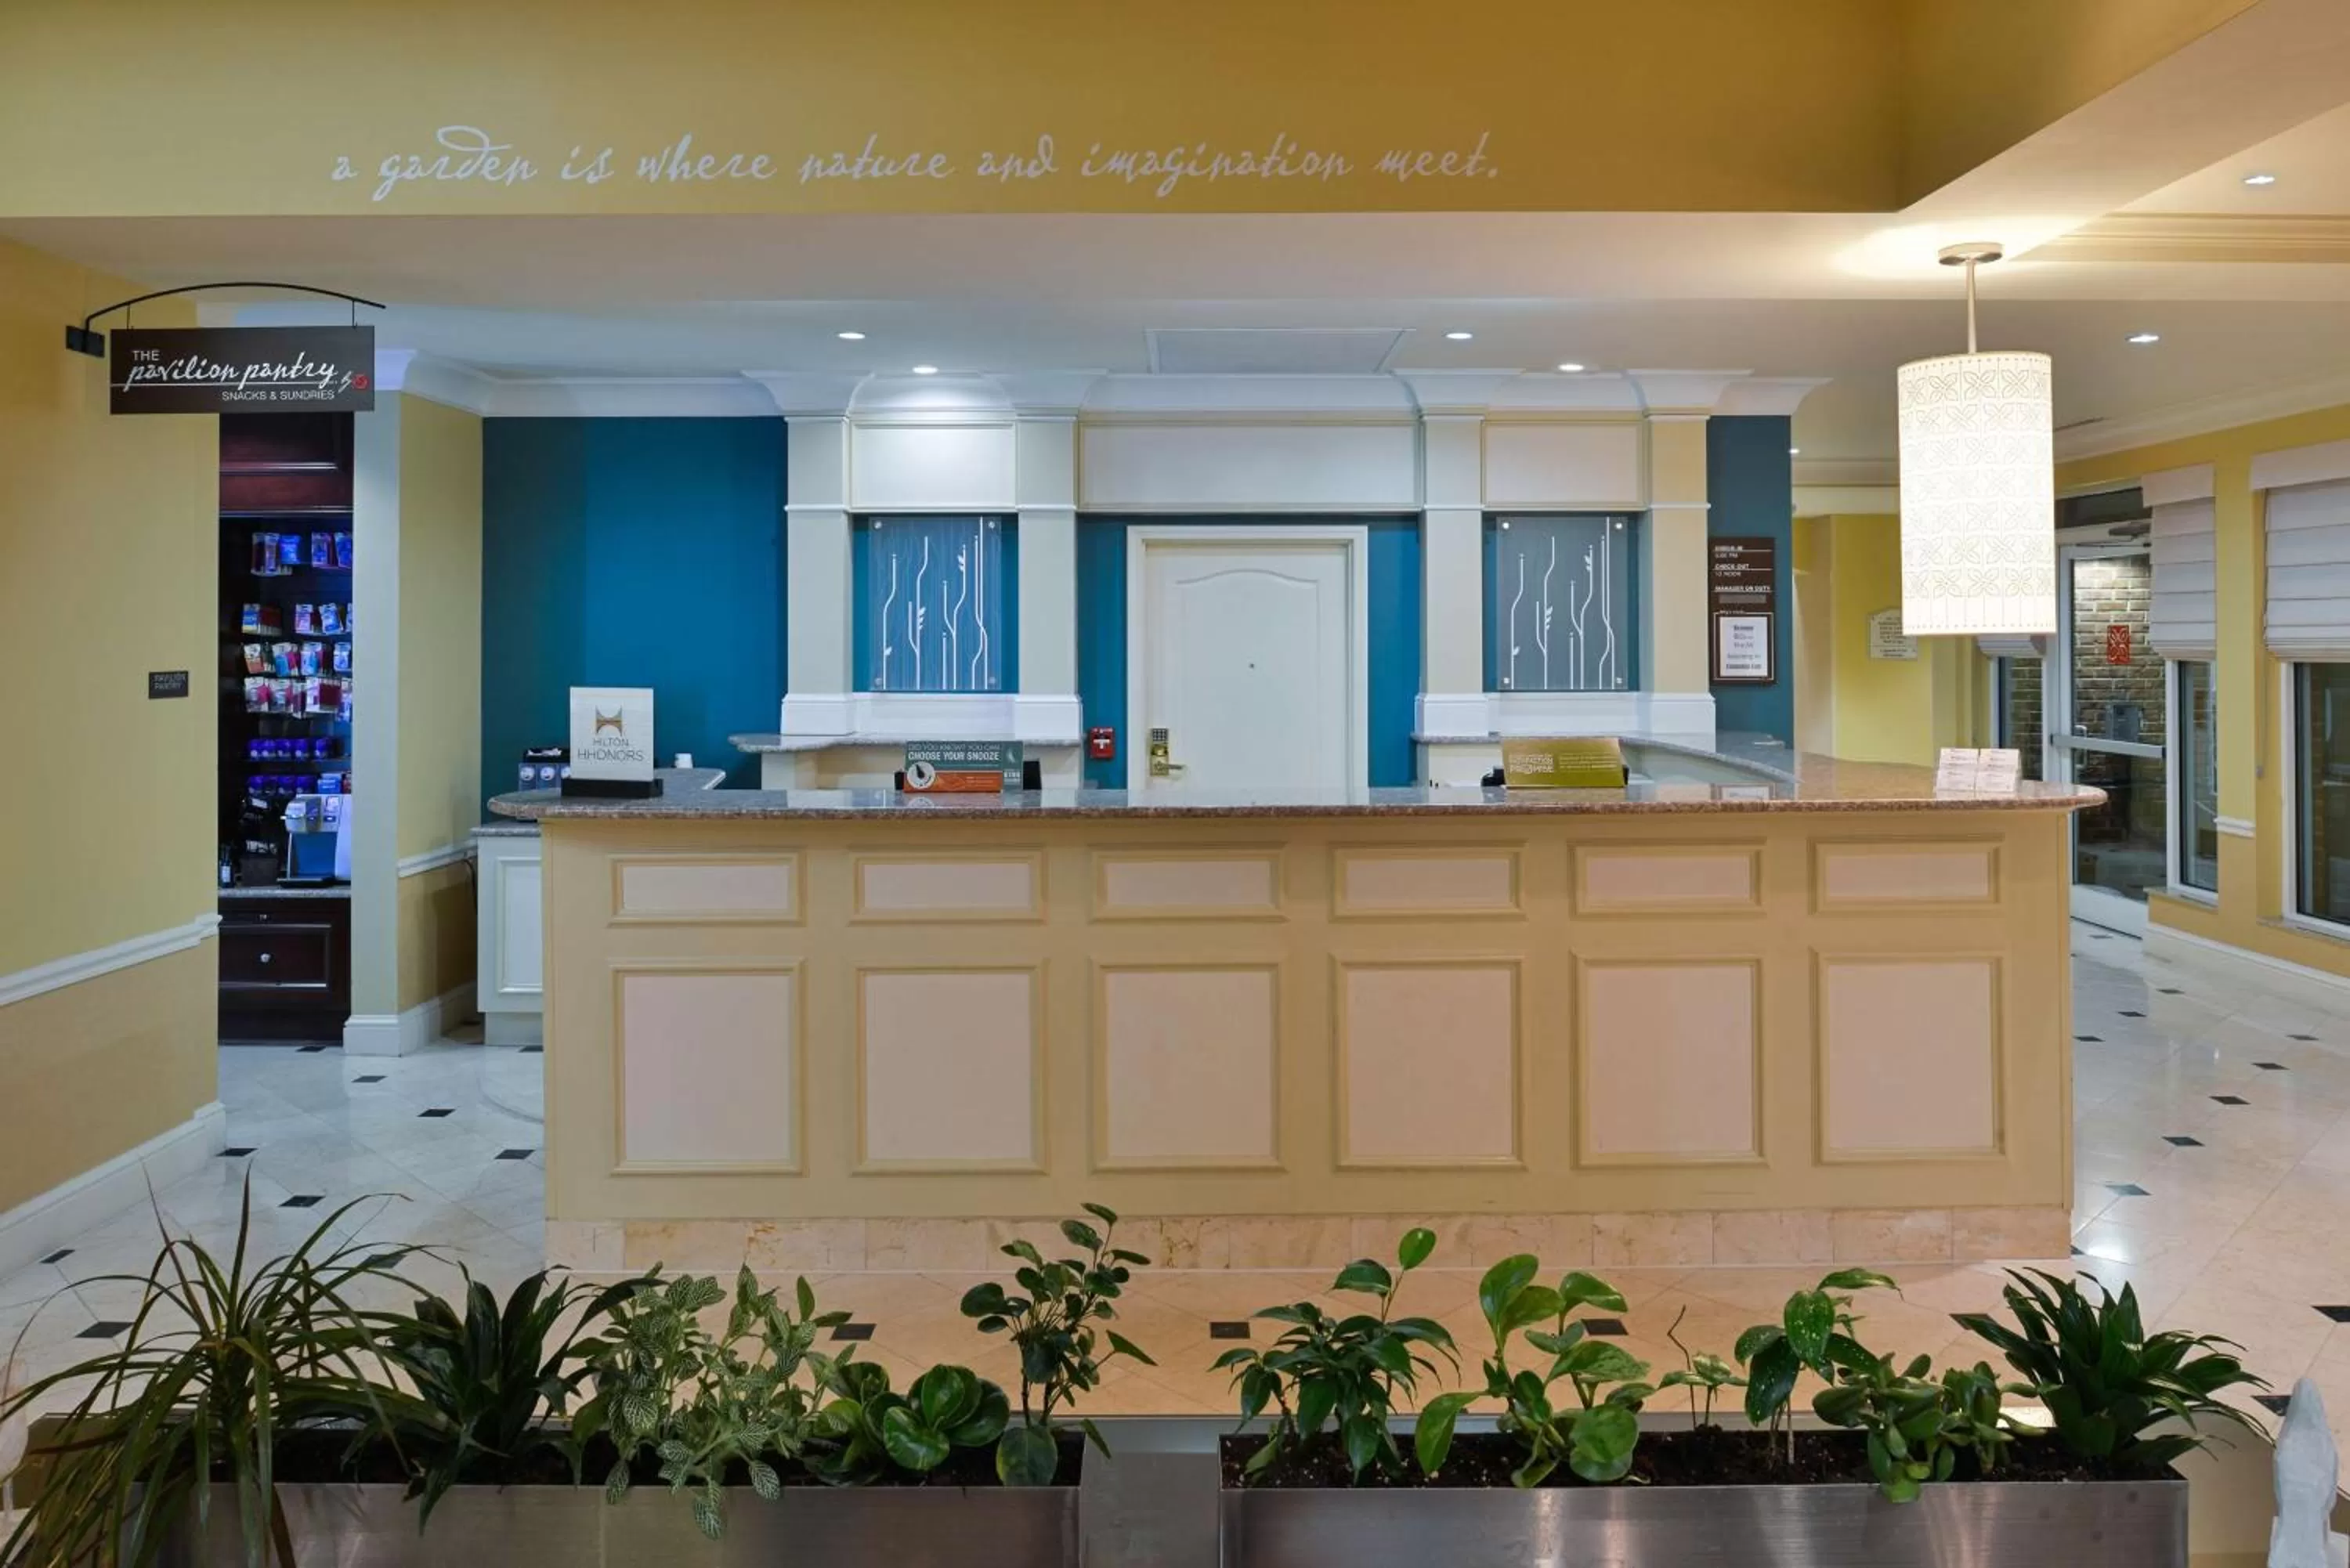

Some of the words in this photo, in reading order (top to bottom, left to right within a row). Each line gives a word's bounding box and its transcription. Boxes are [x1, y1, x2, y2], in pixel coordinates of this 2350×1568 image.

[331, 156, 357, 181] a
[371, 125, 538, 201] garden
[560, 146, 615, 184] is
[636, 132, 776, 183] where
[798, 134, 953, 183] nature
[977, 134, 1059, 183] and
[1080, 133, 1354, 197] imagination
[1374, 132, 1499, 182] meet.
[132, 350, 160, 361] THE
[123, 355, 240, 392] pavilion
[237, 352, 338, 391] pantry
[222, 391, 267, 401] SNACKS
[269, 391, 278, 400] &
[280, 390, 335, 400] SUNDRIES
[592, 737, 629, 747] HILTON
[577, 748, 645, 762] HHONORS
[908, 751, 941, 761] CHOOSE
[942, 751, 965, 761] YOUR
[967, 751, 1000, 761] SNOOZE
